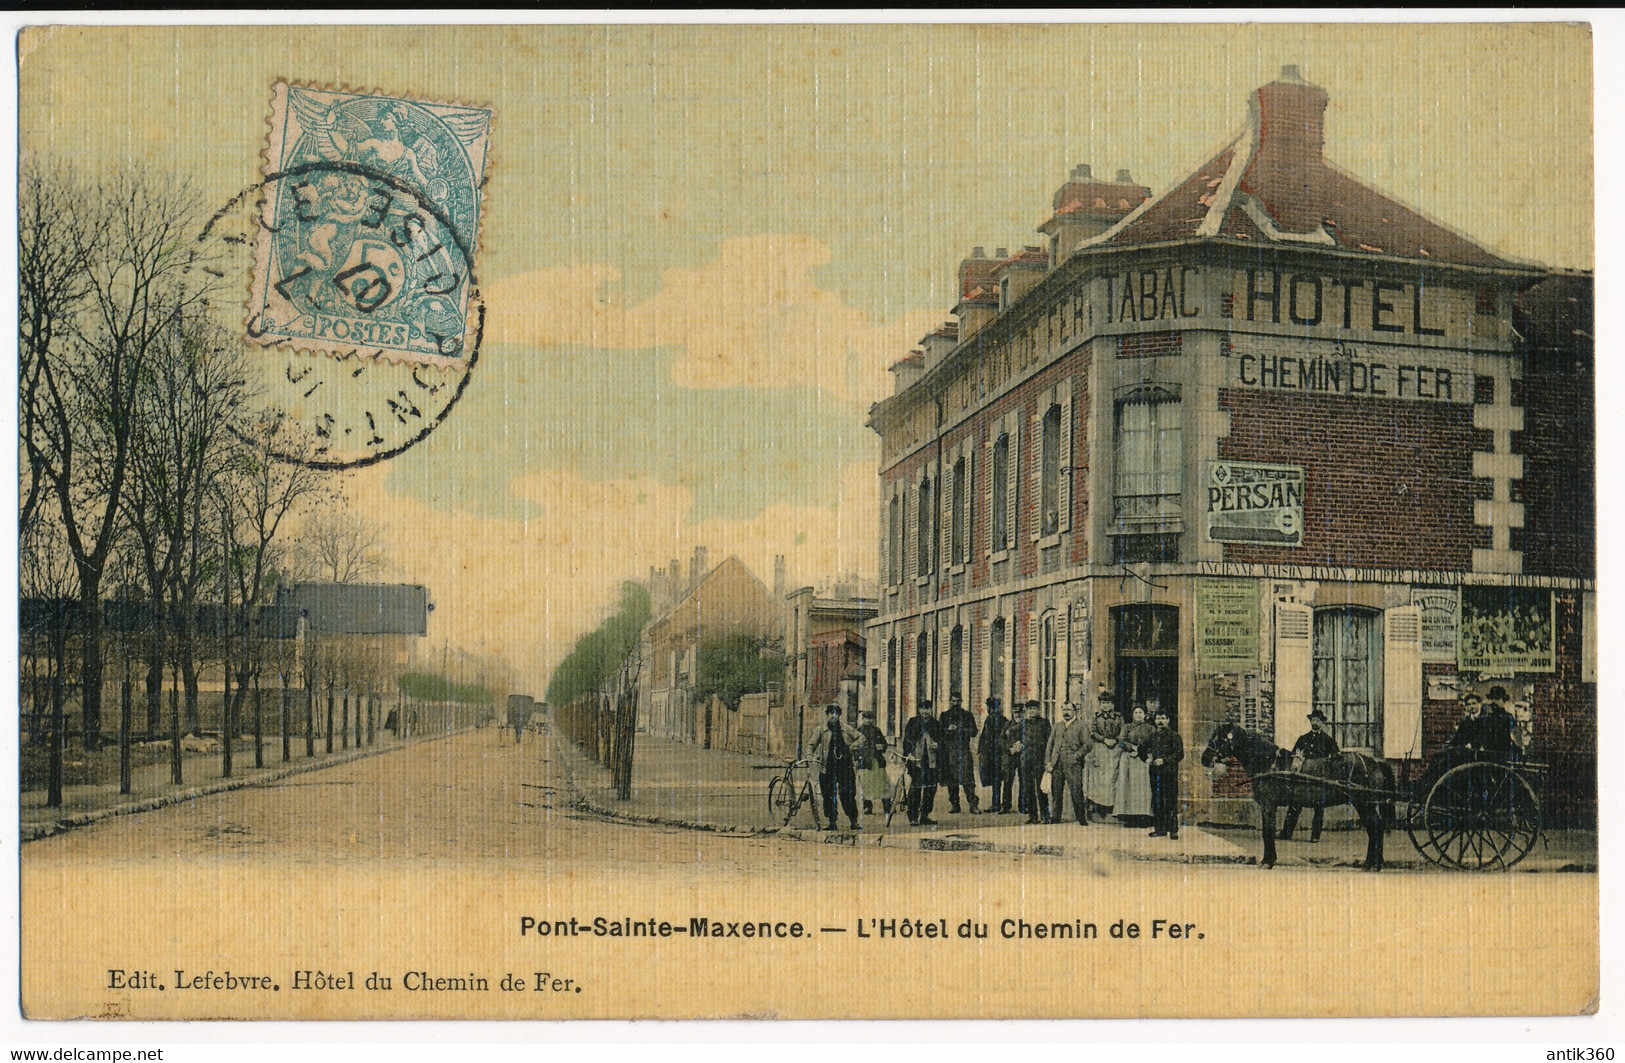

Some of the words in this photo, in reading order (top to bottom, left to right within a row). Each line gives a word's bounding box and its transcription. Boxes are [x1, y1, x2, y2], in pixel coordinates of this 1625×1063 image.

[1104, 267, 1200, 323] TABAC
[1246, 267, 1445, 337] HOTEL
[316, 316, 406, 346] POSTES
[1239, 353, 1341, 392] CHEMIN
[1349, 361, 1387, 396] DE
[1399, 365, 1453, 400] FER
[1207, 482, 1303, 512] PERSAN
[1200, 562, 1254, 576] ANCIENNE
[1262, 564, 1304, 579] MAISON
[1356, 567, 1406, 582] PHILIPPE
[521, 916, 812, 938] Pont-Sainte-Maxence.
[857, 918, 949, 938] L'Hôtel
[957, 918, 988, 939] du
[1000, 918, 1097, 939] Chemin
[1109, 919, 1140, 939] de
[1152, 919, 1205, 939] Fer.
[107, 969, 165, 992] Edit.
[174, 970, 280, 992] Lefebvre.
[292, 970, 355, 990] Hôtel
[365, 971, 393, 991] du
[403, 971, 489, 992] Chemin
[500, 973, 525, 992] de
[533, 972, 582, 994] Fer.
